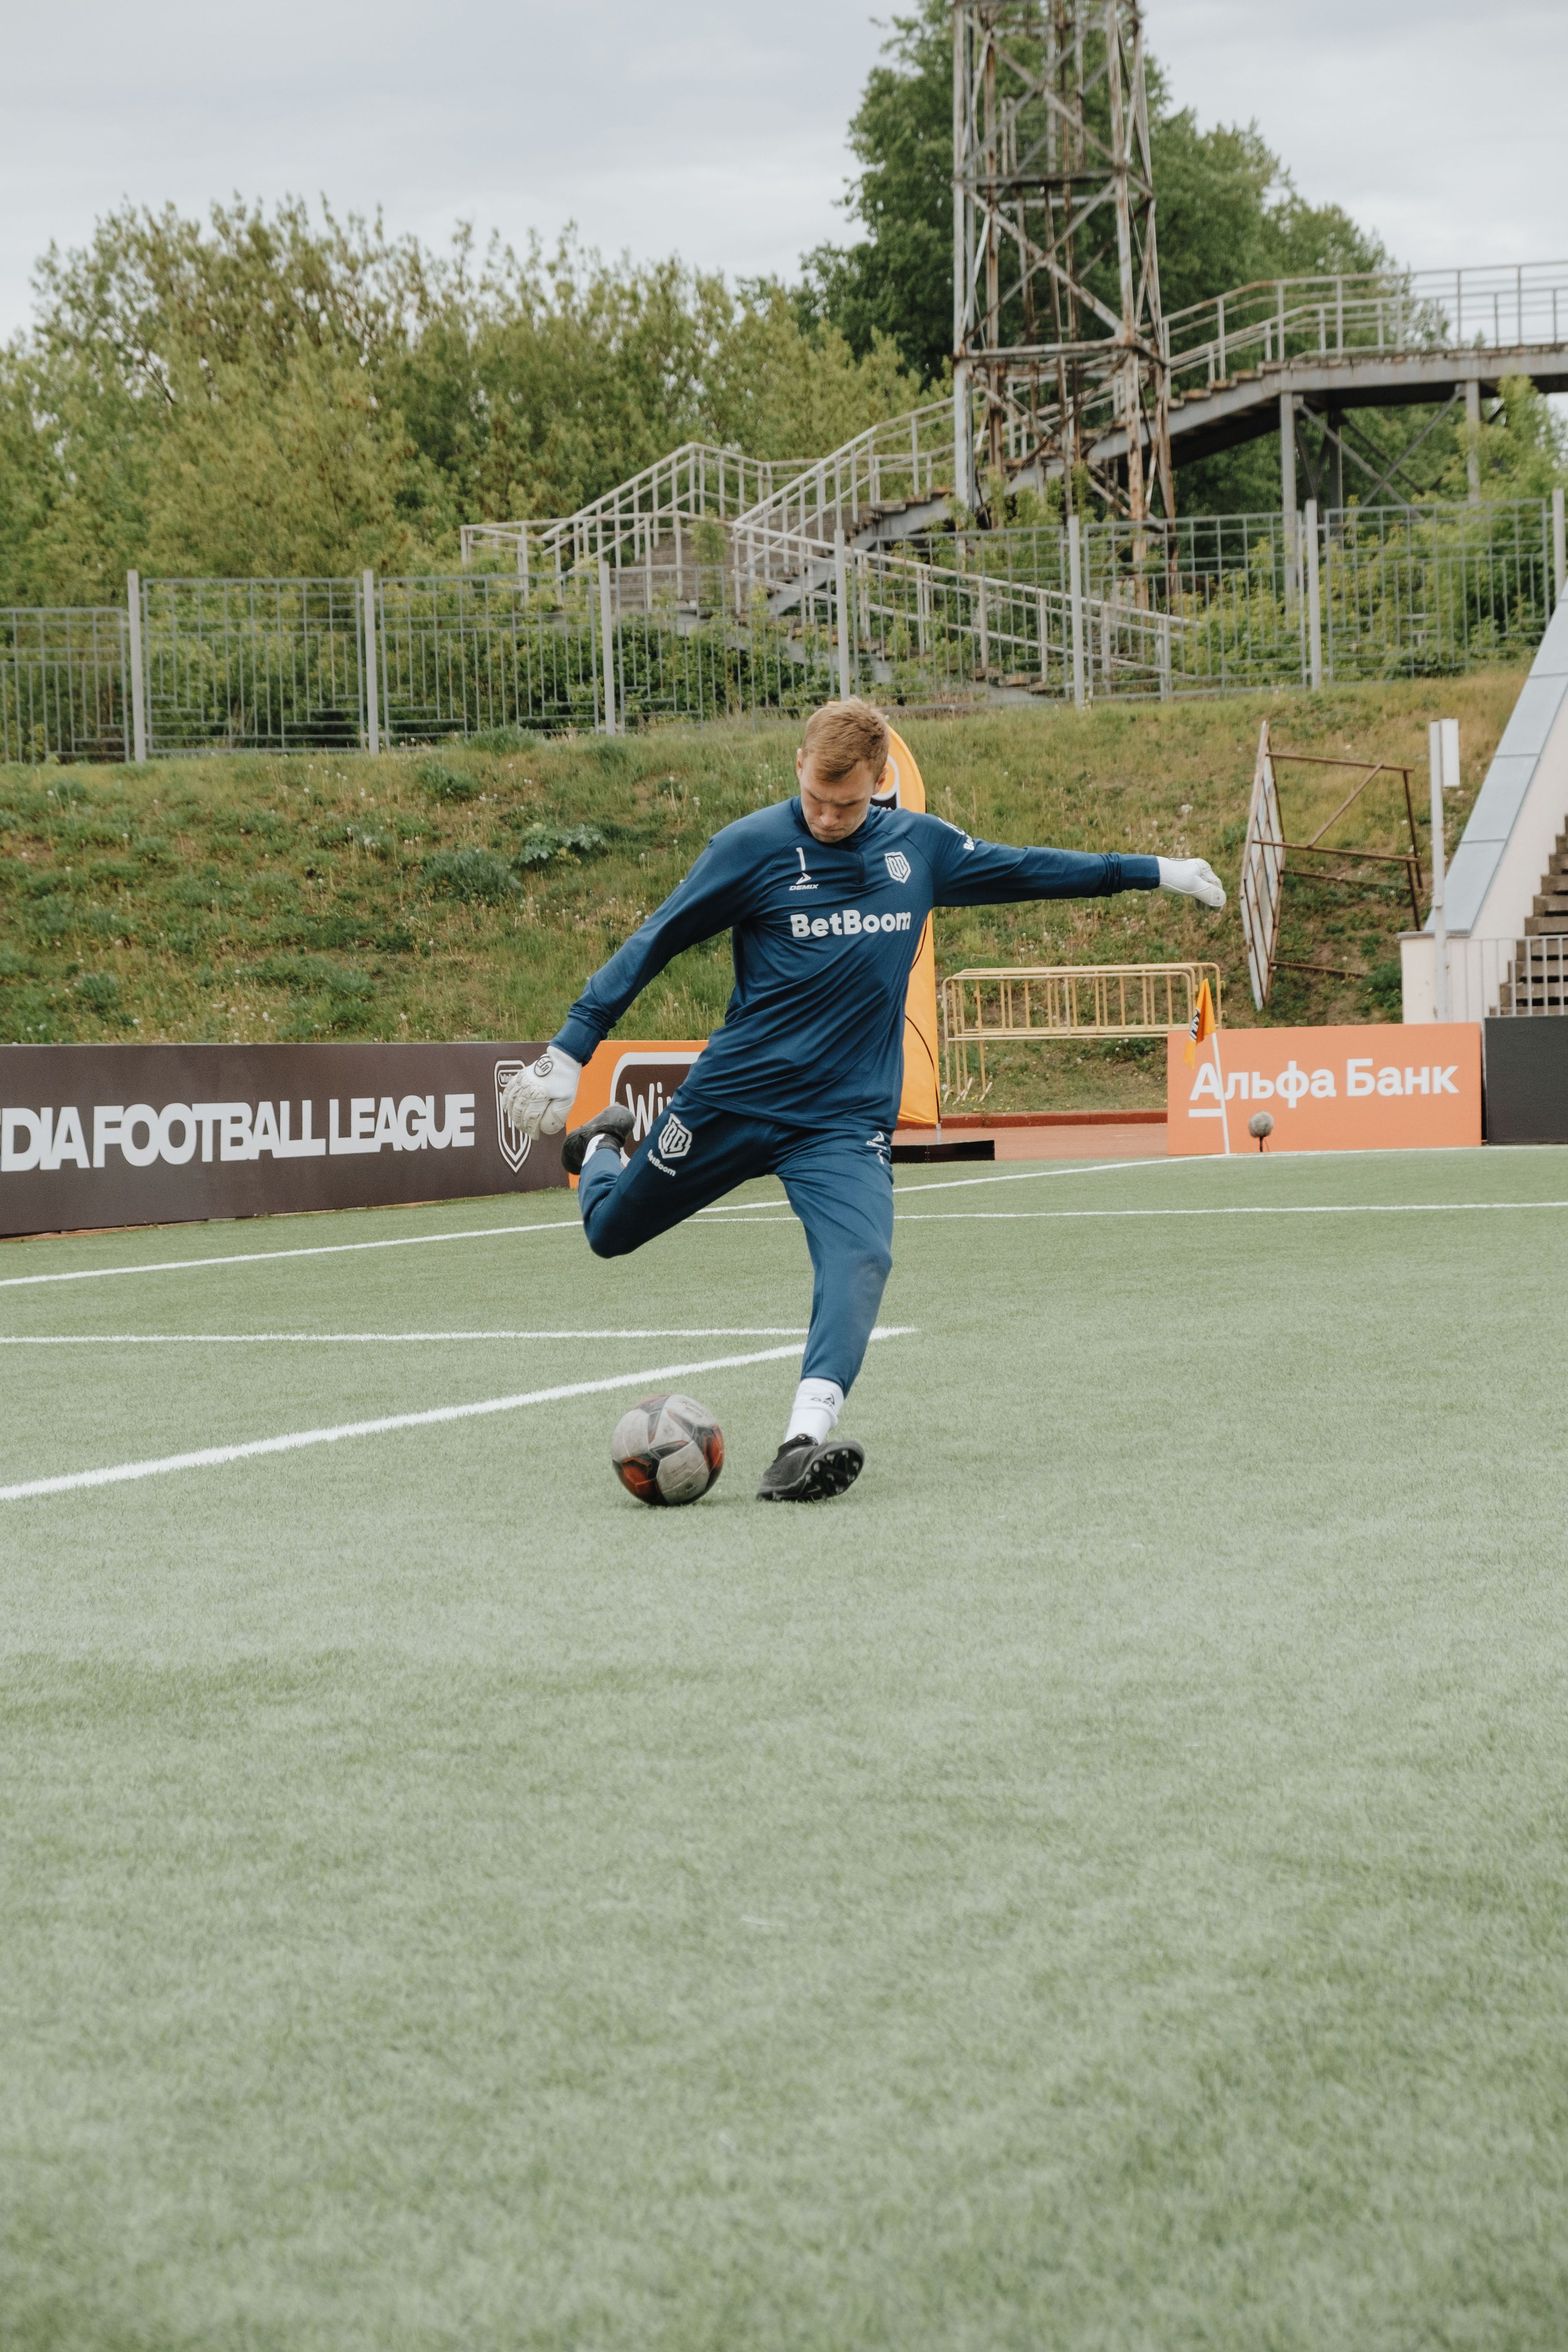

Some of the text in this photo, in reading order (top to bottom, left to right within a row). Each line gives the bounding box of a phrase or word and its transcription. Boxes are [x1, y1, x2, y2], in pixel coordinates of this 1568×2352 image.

[790, 910, 912, 938] BetBoom
[1189, 1058, 1460, 1108] Альфа Банк
[0, 1106, 91, 1172] DIA
[92, 1100, 327, 1169] FOOTBALL
[329, 1093, 476, 1156] LEAGUE
